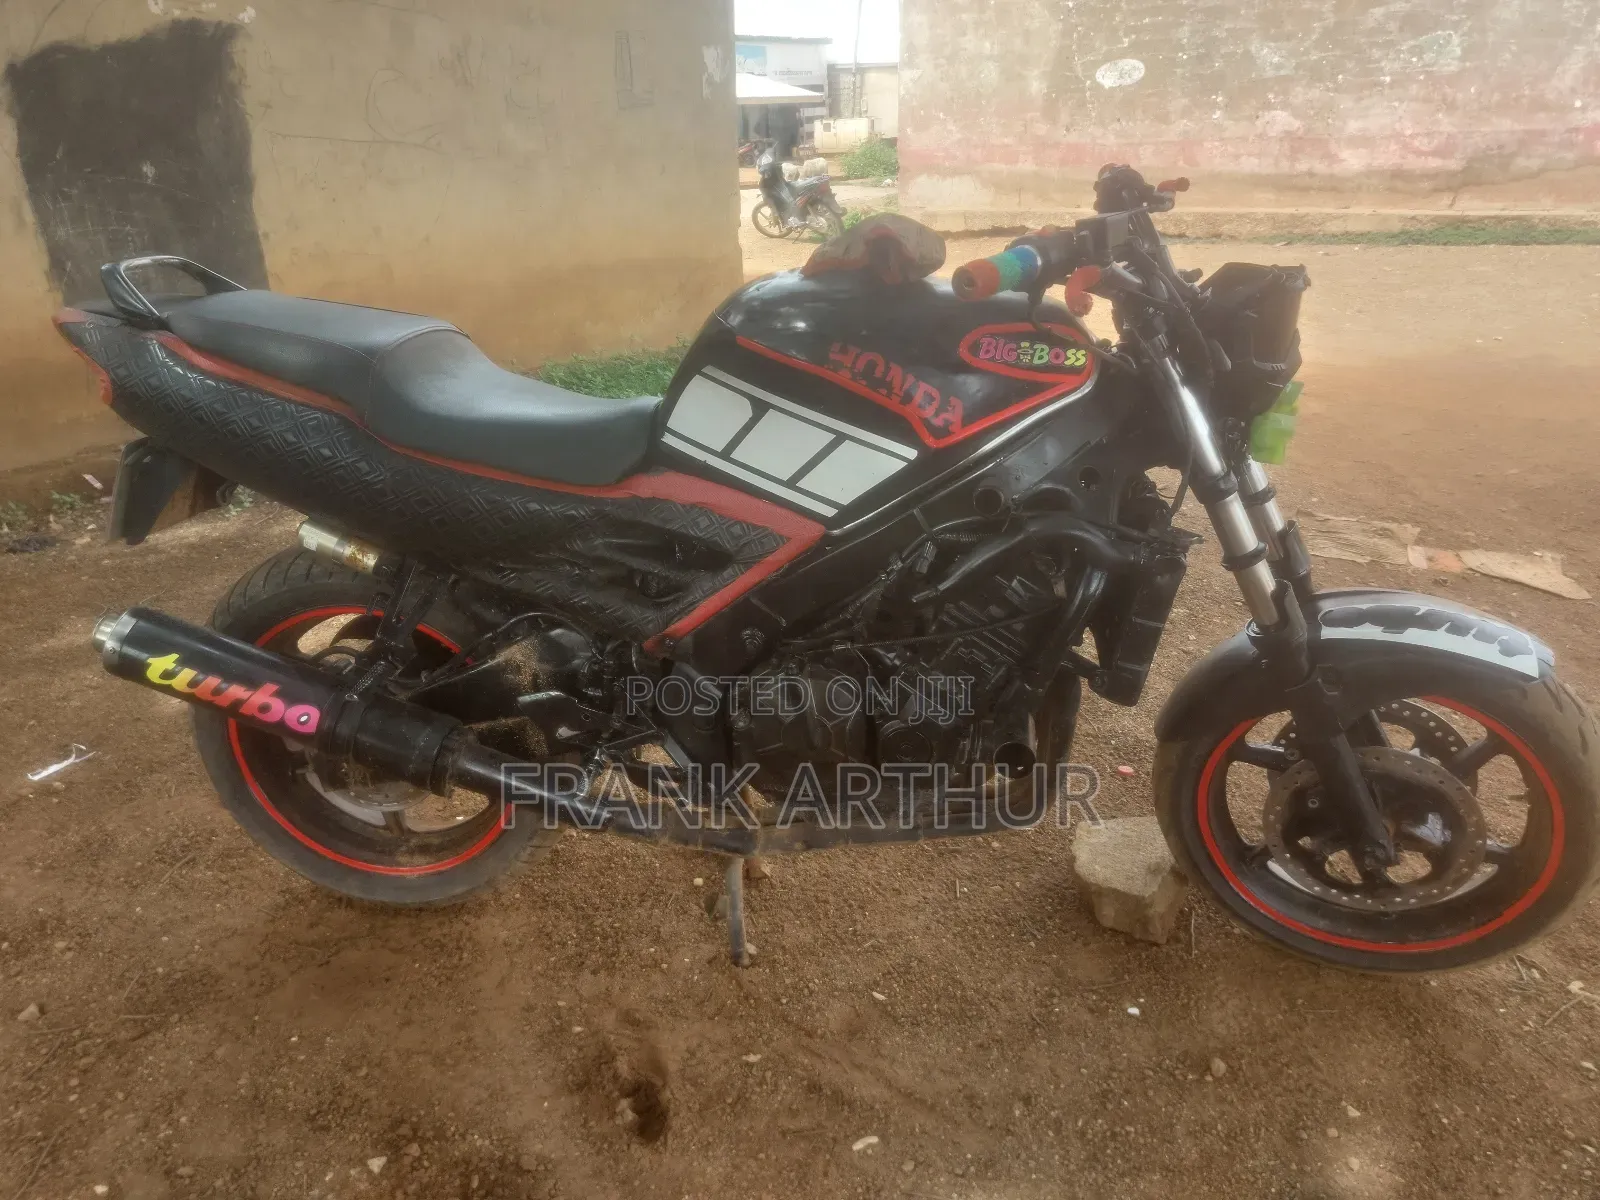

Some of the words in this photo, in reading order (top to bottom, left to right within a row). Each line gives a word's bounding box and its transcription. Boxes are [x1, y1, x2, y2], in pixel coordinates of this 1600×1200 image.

[827, 341, 964, 433] HONDA
[978, 336, 1018, 362] BIG
[1032, 343, 1087, 366] BOSS
[146, 652, 321, 733] turbo
